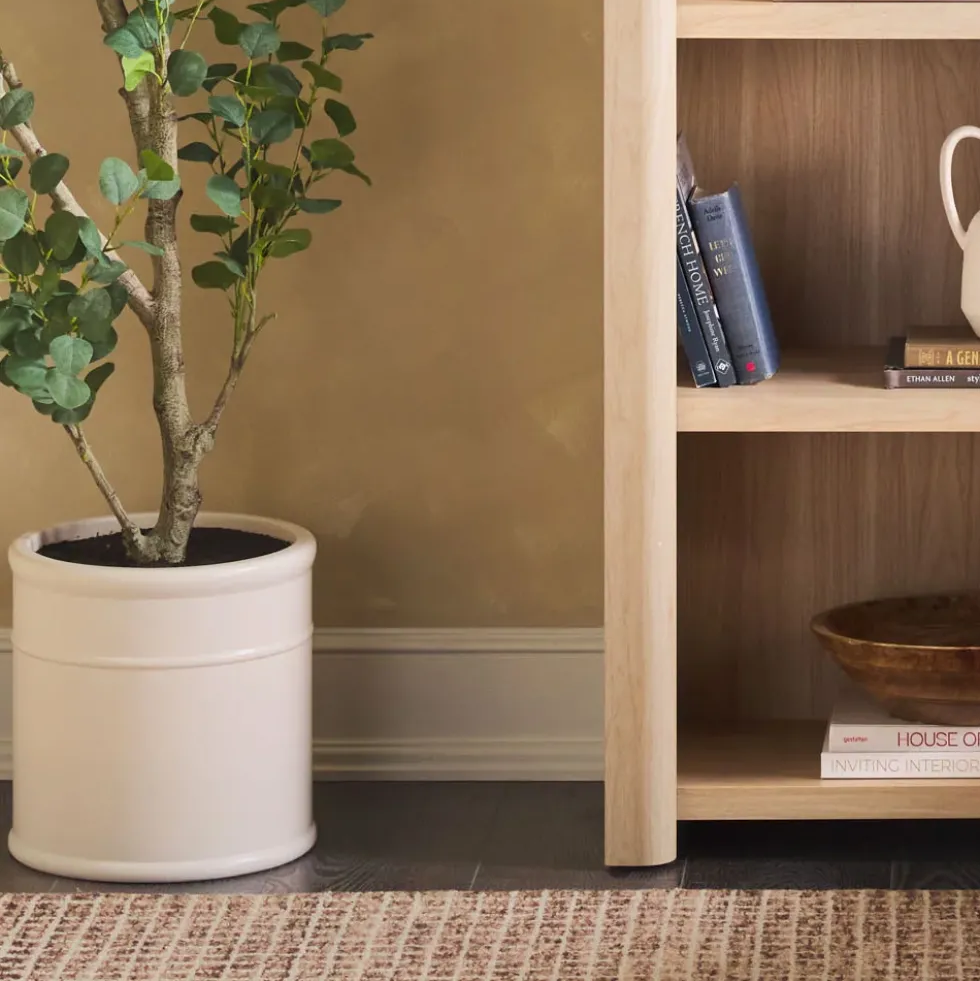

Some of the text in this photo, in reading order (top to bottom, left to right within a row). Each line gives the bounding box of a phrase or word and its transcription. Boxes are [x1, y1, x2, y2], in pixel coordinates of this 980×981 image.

[686, 259, 709, 306] HOME
[710, 336, 720, 353] Ryan
[945, 350, 953, 366] A
[906, 375, 931, 383] ETHAN
[932, 375, 956, 383] ALLEN
[897, 731, 958, 747] HOUSE
[831, 759, 900, 773] INVITING
